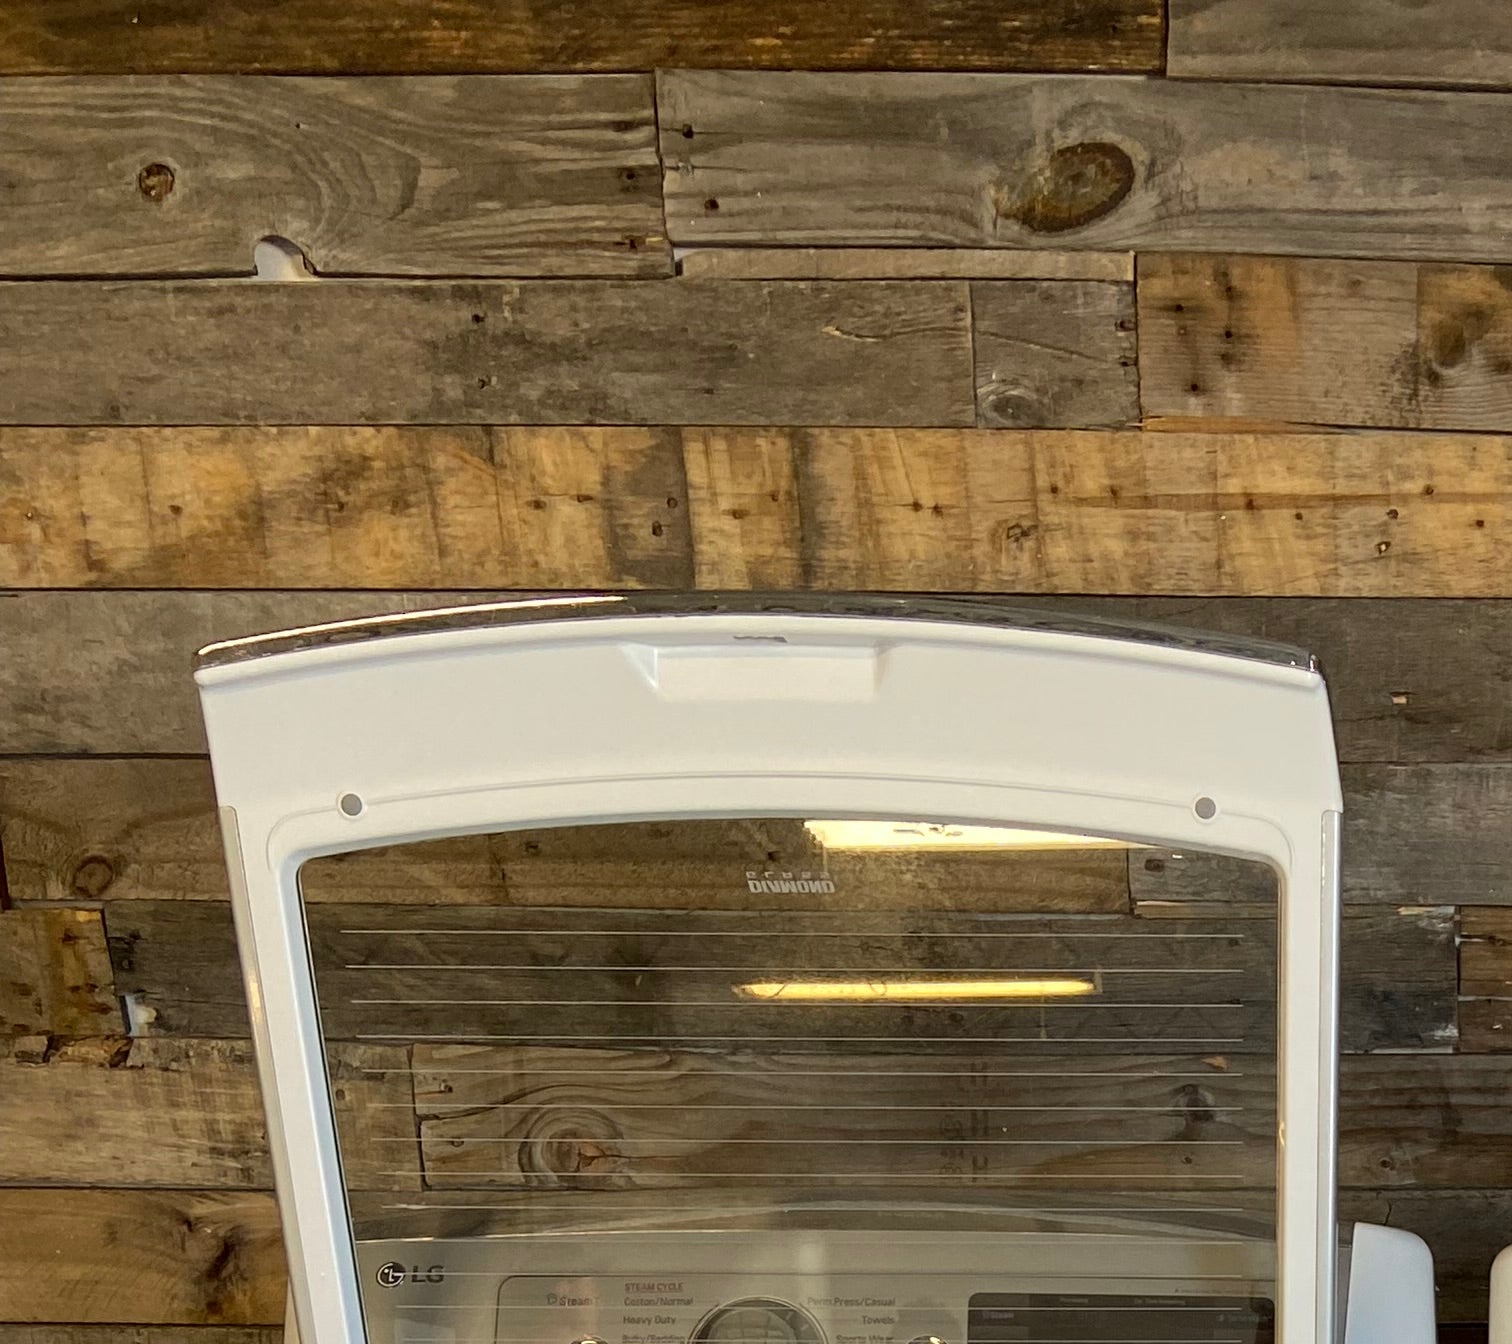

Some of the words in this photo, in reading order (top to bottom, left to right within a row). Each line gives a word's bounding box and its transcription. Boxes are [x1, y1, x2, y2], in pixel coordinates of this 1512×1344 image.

[411, 1265, 444, 1283] LG
[622, 1315, 652, 1325] Heavy
[654, 1315, 676, 1325] Duty
[862, 1315, 895, 1325] Towels
